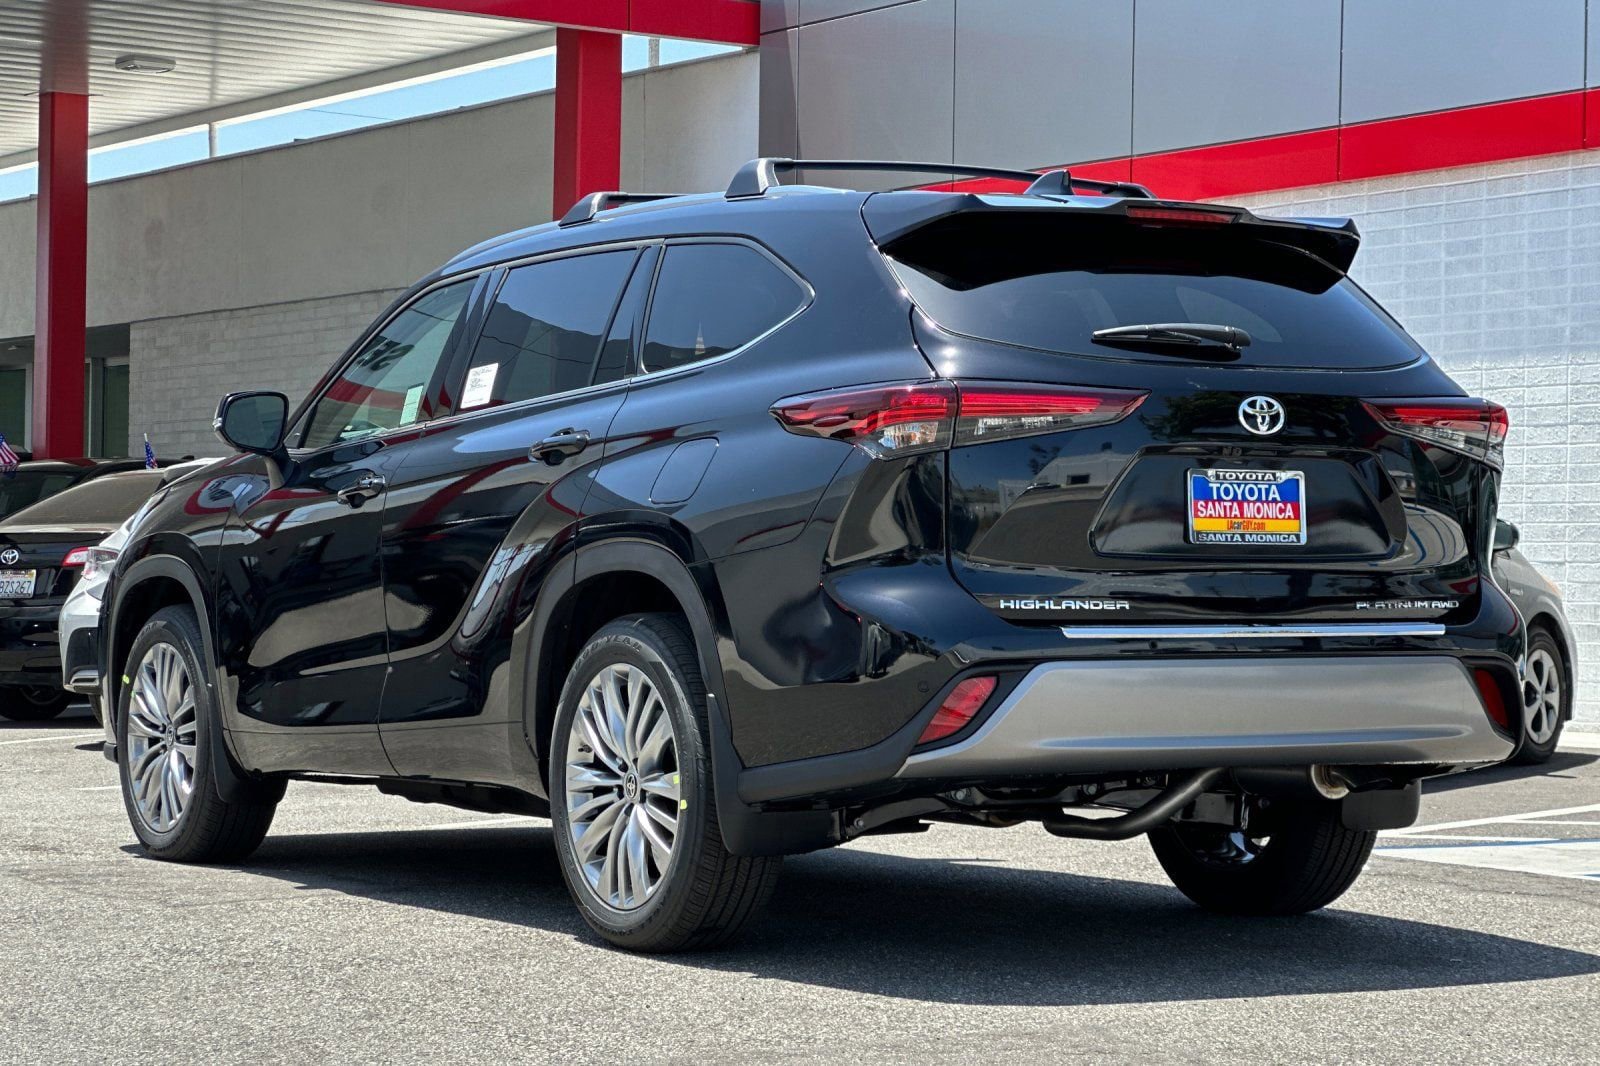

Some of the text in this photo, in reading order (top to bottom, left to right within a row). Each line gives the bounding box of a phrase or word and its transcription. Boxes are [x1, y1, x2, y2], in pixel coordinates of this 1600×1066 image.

[1216, 471, 1275, 481] TOYOTA
[1208, 483, 1282, 501] TOYOTA
[1197, 501, 1295, 519] SANTA MONICA
[1198, 533, 1298, 543] SANTA MONICA
[999, 599, 1131, 610] HIGHLANDER
[1356, 600, 1460, 610] PLATINUM AWD
